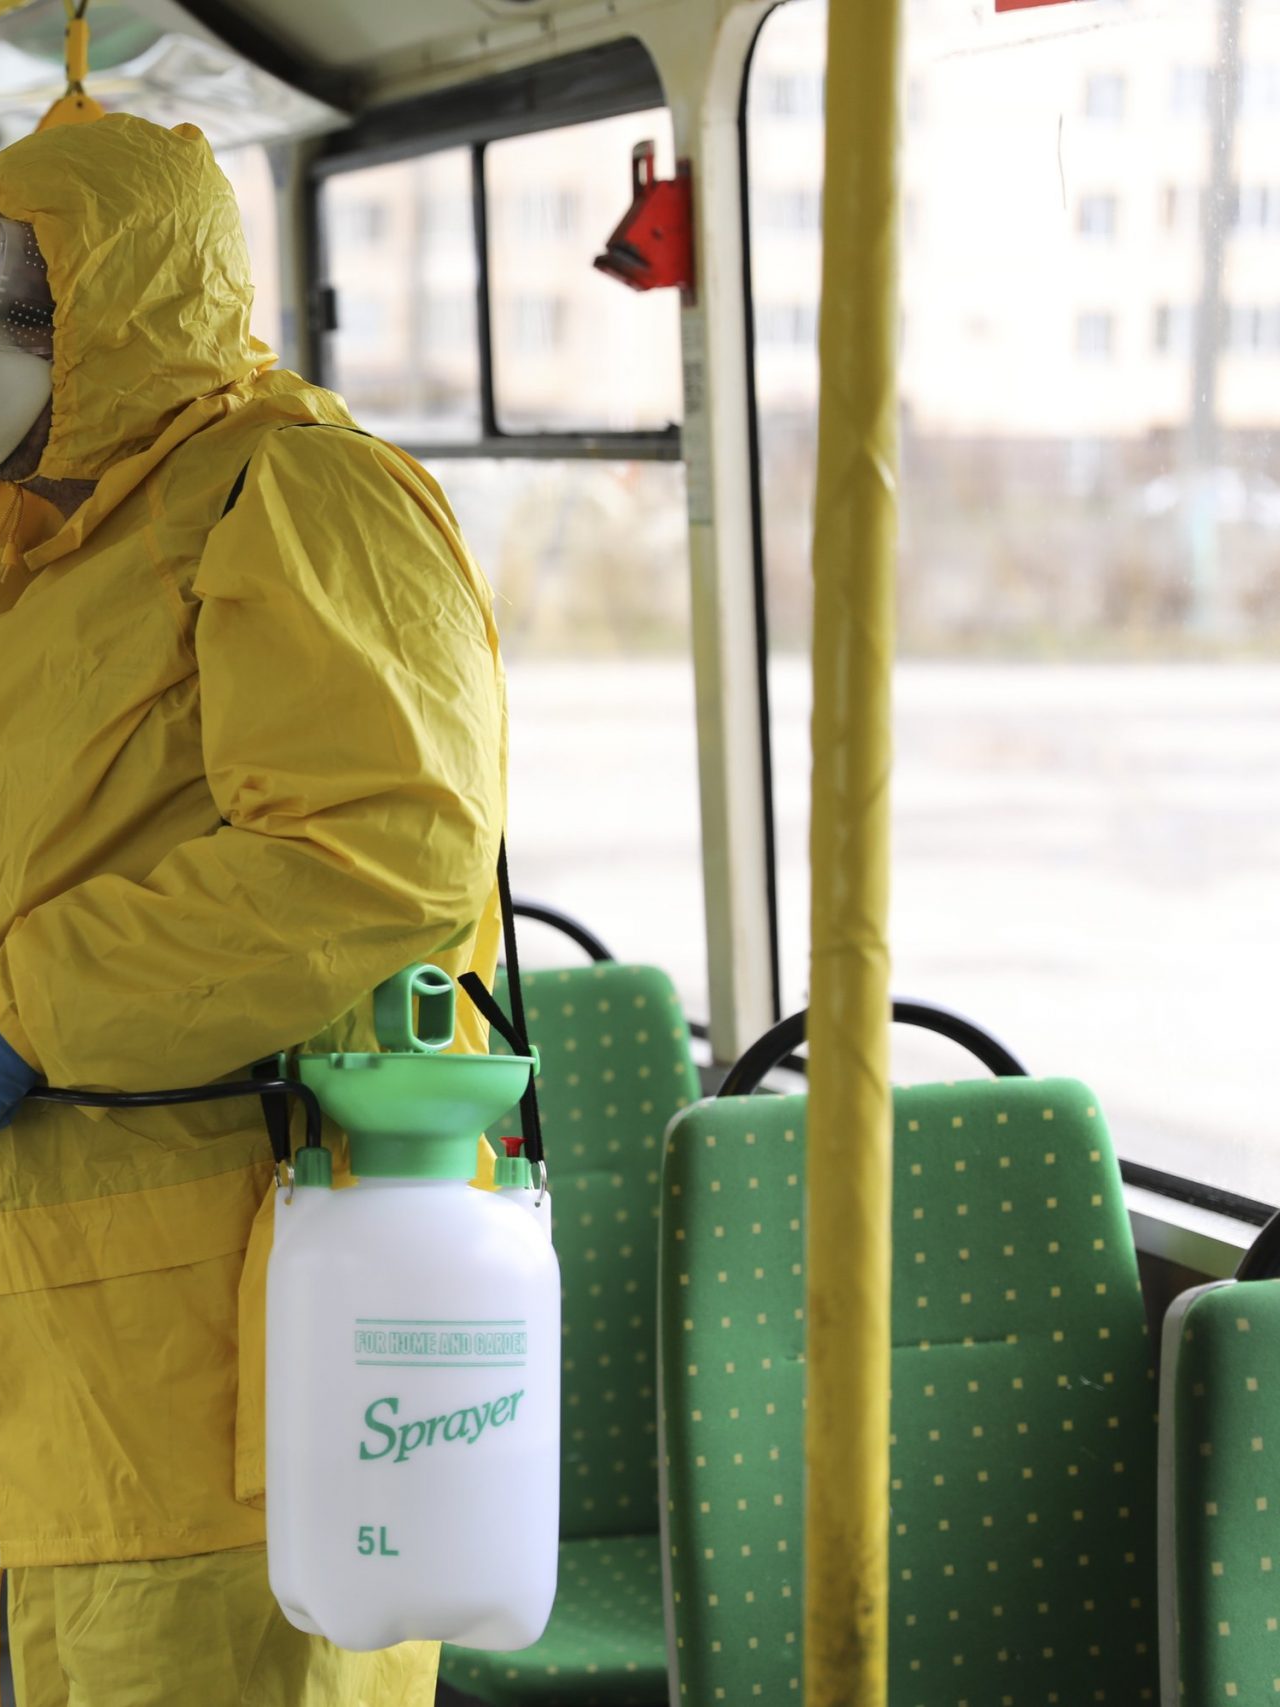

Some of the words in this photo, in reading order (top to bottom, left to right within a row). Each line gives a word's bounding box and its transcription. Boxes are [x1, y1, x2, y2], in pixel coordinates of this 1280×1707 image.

[355, 1331, 386, 1353] FOR
[388, 1331, 437, 1355] HOME
[438, 1332, 472, 1355] AND
[474, 1332, 527, 1355] GARDEN
[359, 1389, 525, 1463] Sprayer
[357, 1525, 399, 1556] 5L
